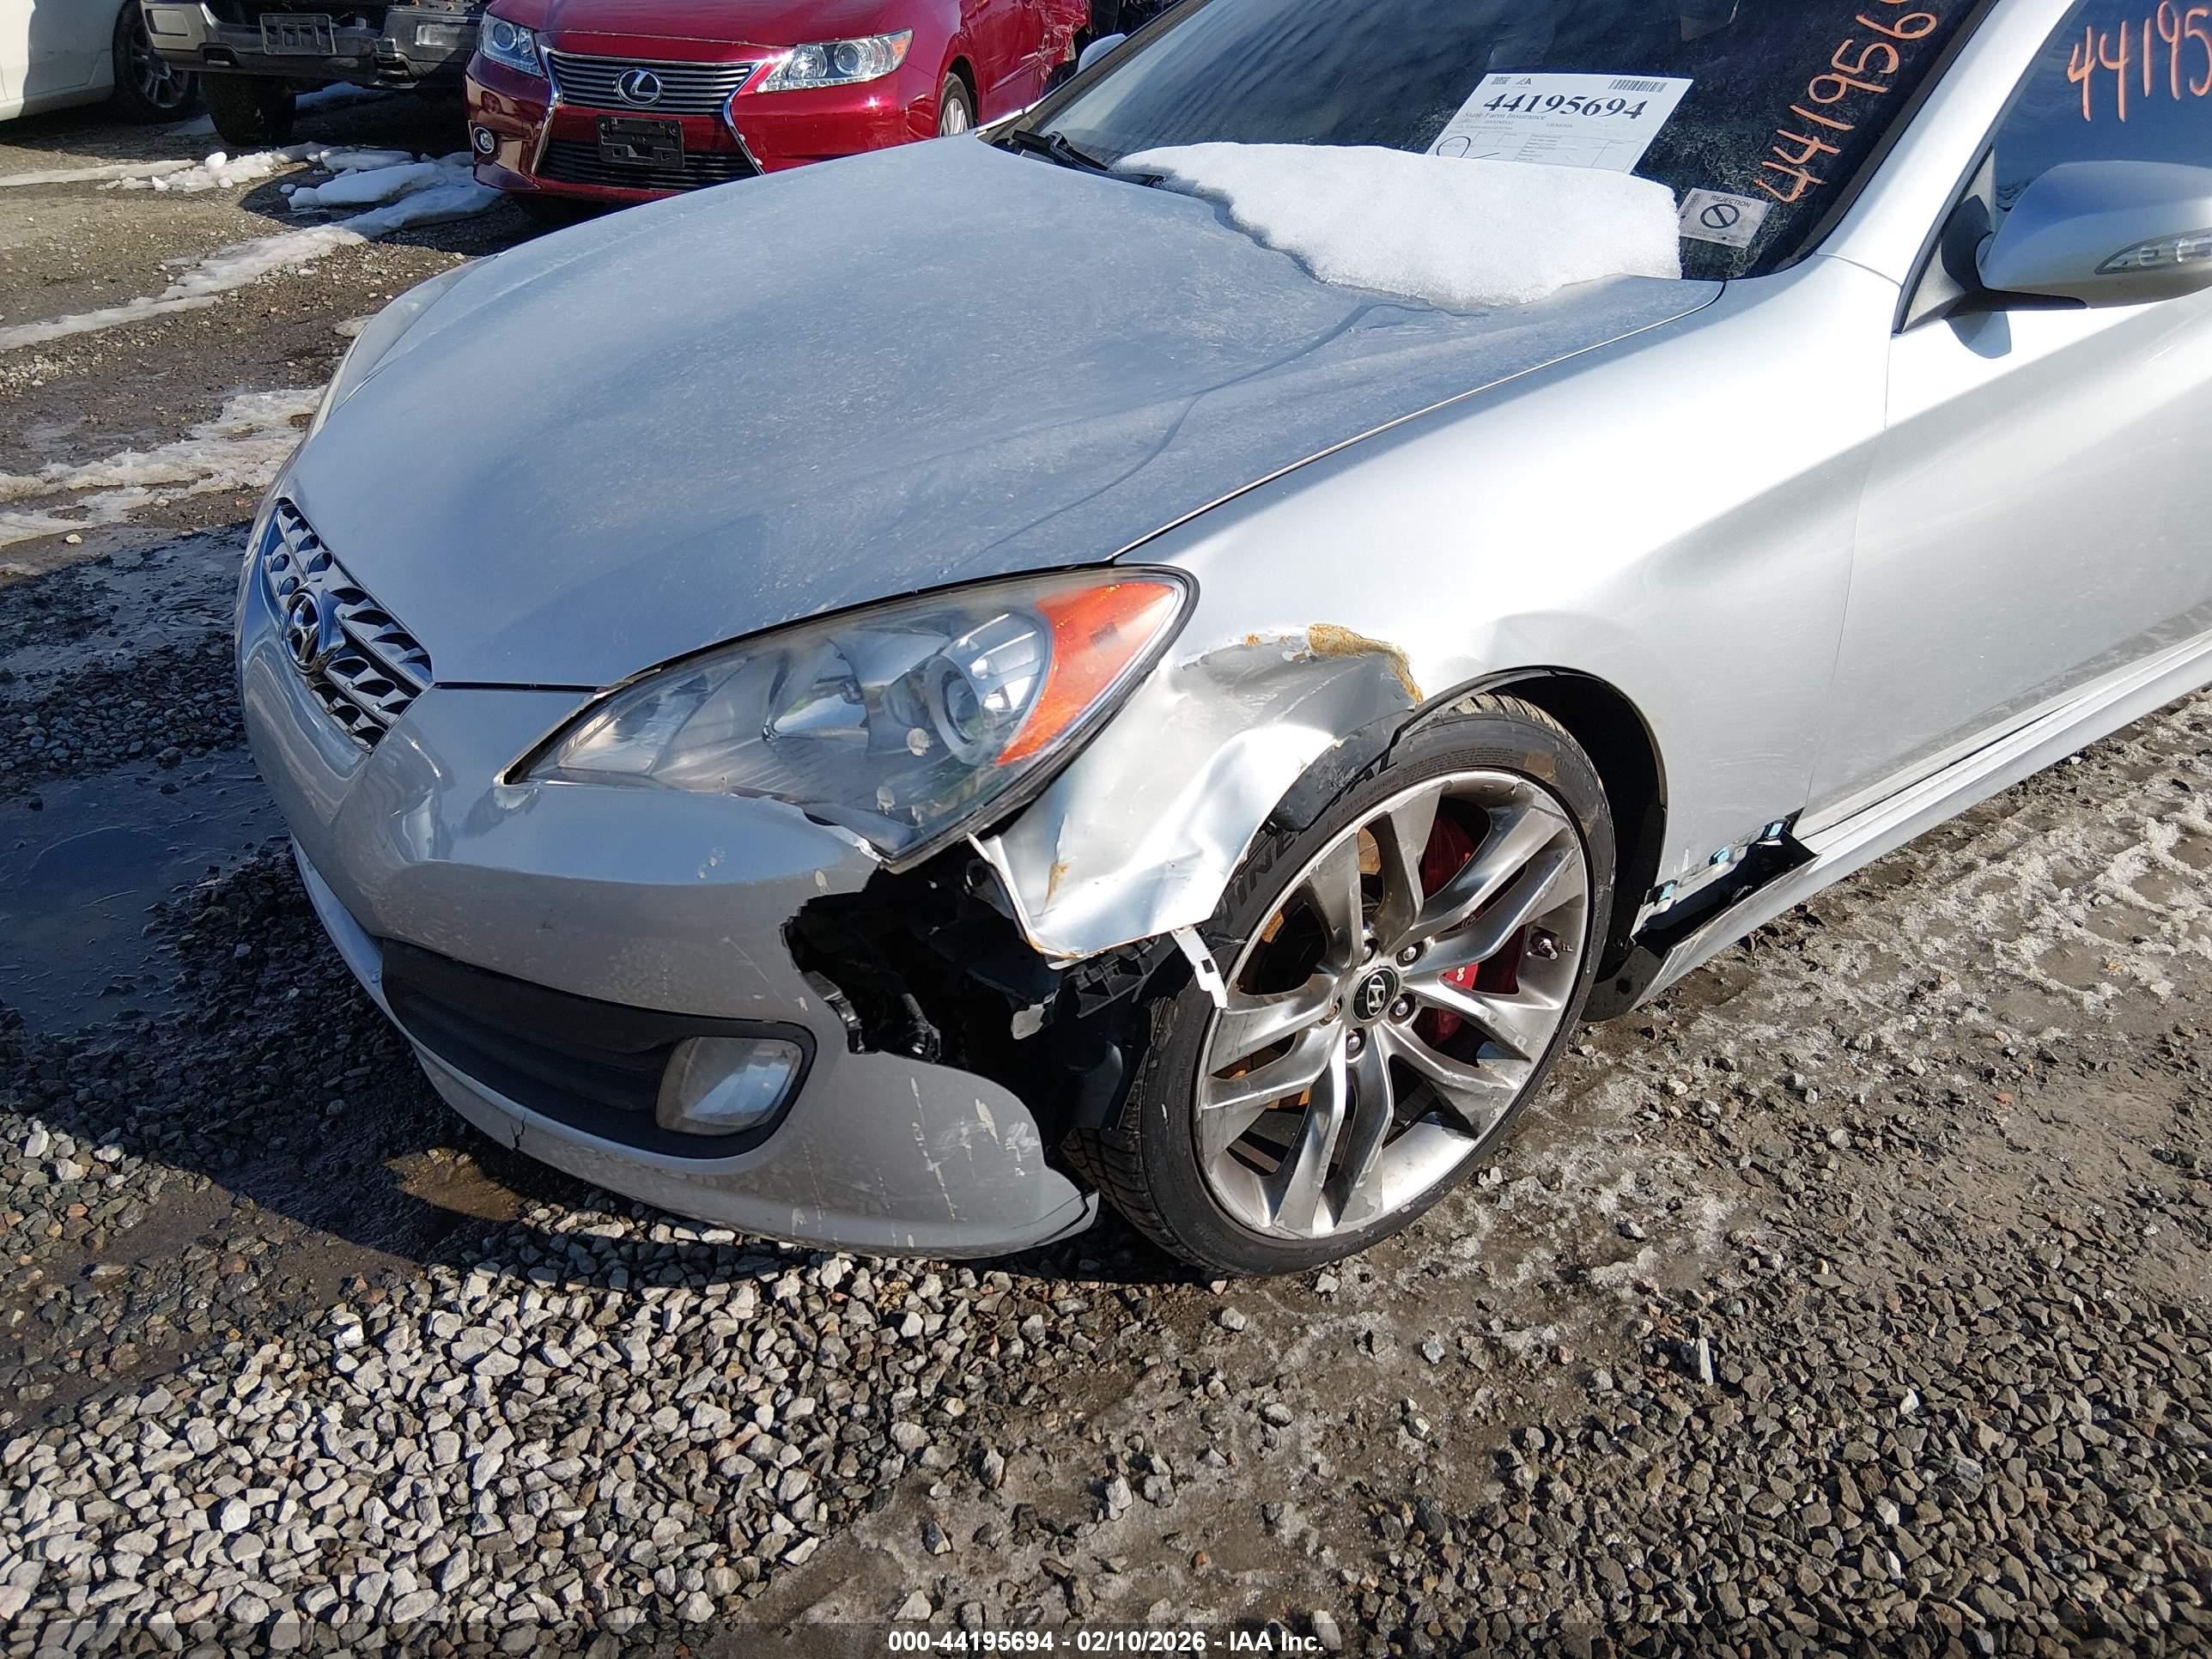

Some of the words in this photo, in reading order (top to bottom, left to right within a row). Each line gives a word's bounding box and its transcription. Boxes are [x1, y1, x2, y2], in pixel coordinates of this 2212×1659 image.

[2067, 1, 2212, 122] 44195
[1483, 93, 1649, 119] 44195694
[1753, 0, 1937, 203] 441956
[1711, 195, 1752, 208] REJECTION
